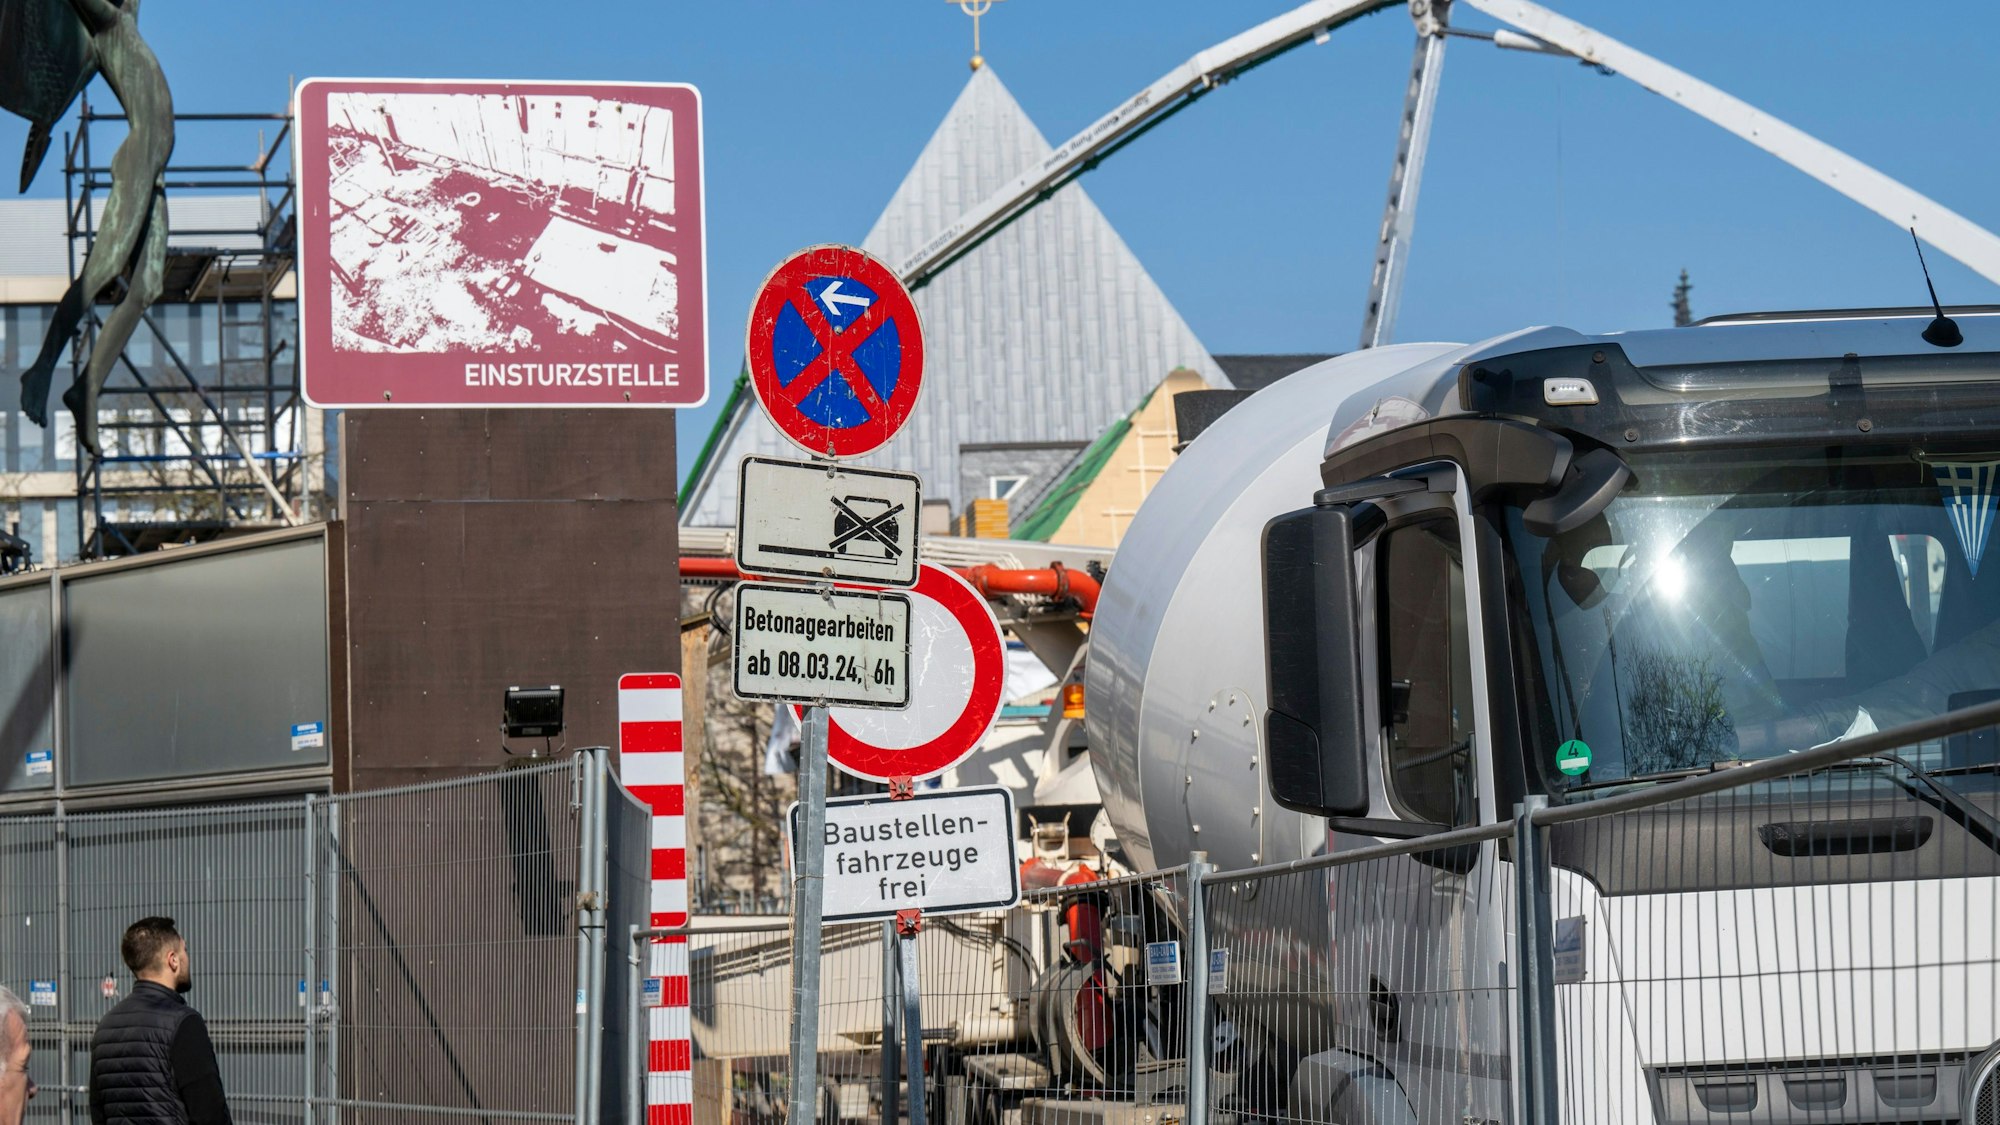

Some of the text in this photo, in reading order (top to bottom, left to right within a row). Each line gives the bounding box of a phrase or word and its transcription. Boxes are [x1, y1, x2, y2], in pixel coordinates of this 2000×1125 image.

[464, 363, 680, 386] EINSTURZSTELLE
[744, 606, 894, 642] Betonagearbeiten
[747, 649, 895, 686] ab 08.03.24, 6h
[1568, 741, 1579, 757] 4
[824, 813, 988, 845] Baustellen-
[836, 846, 979, 875] fahrzeuge
[879, 874, 926, 900] frei
